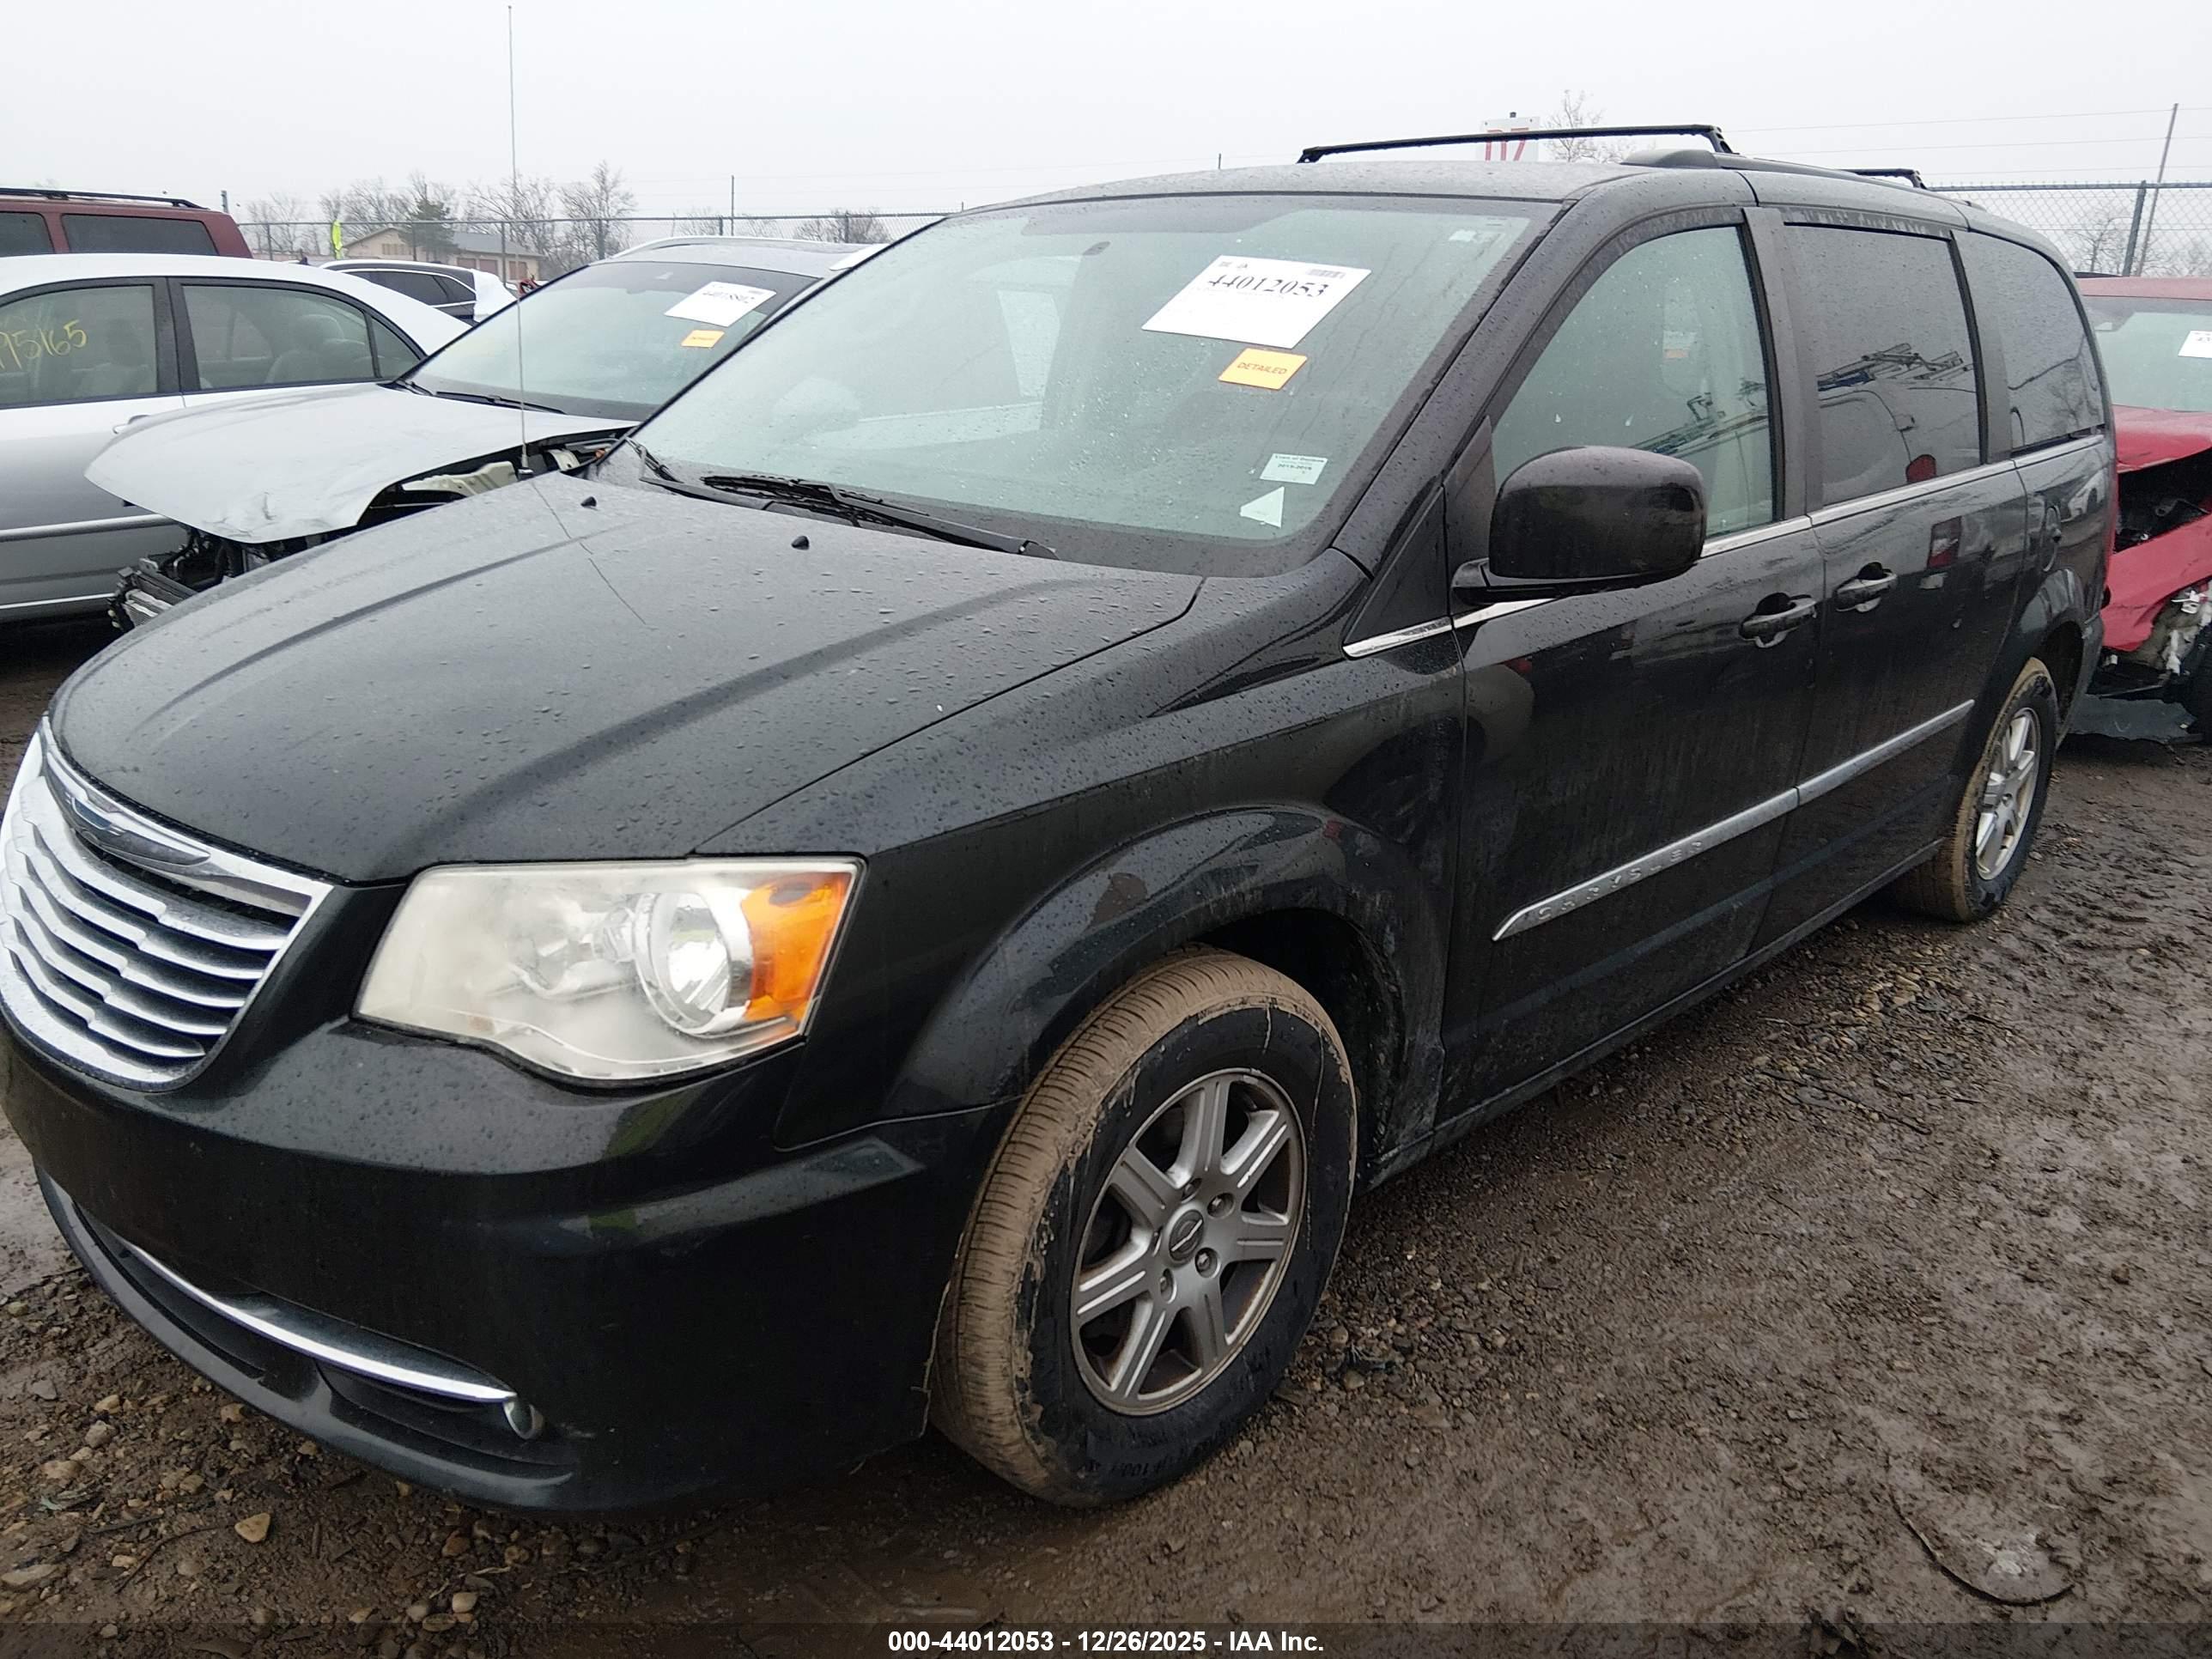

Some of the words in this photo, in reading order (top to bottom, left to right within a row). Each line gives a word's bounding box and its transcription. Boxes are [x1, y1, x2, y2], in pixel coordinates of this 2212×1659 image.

[1208, 274, 1329, 297] 44012053
[0, 319, 87, 369] 95165
[1237, 362, 1287, 374] DETAILED
